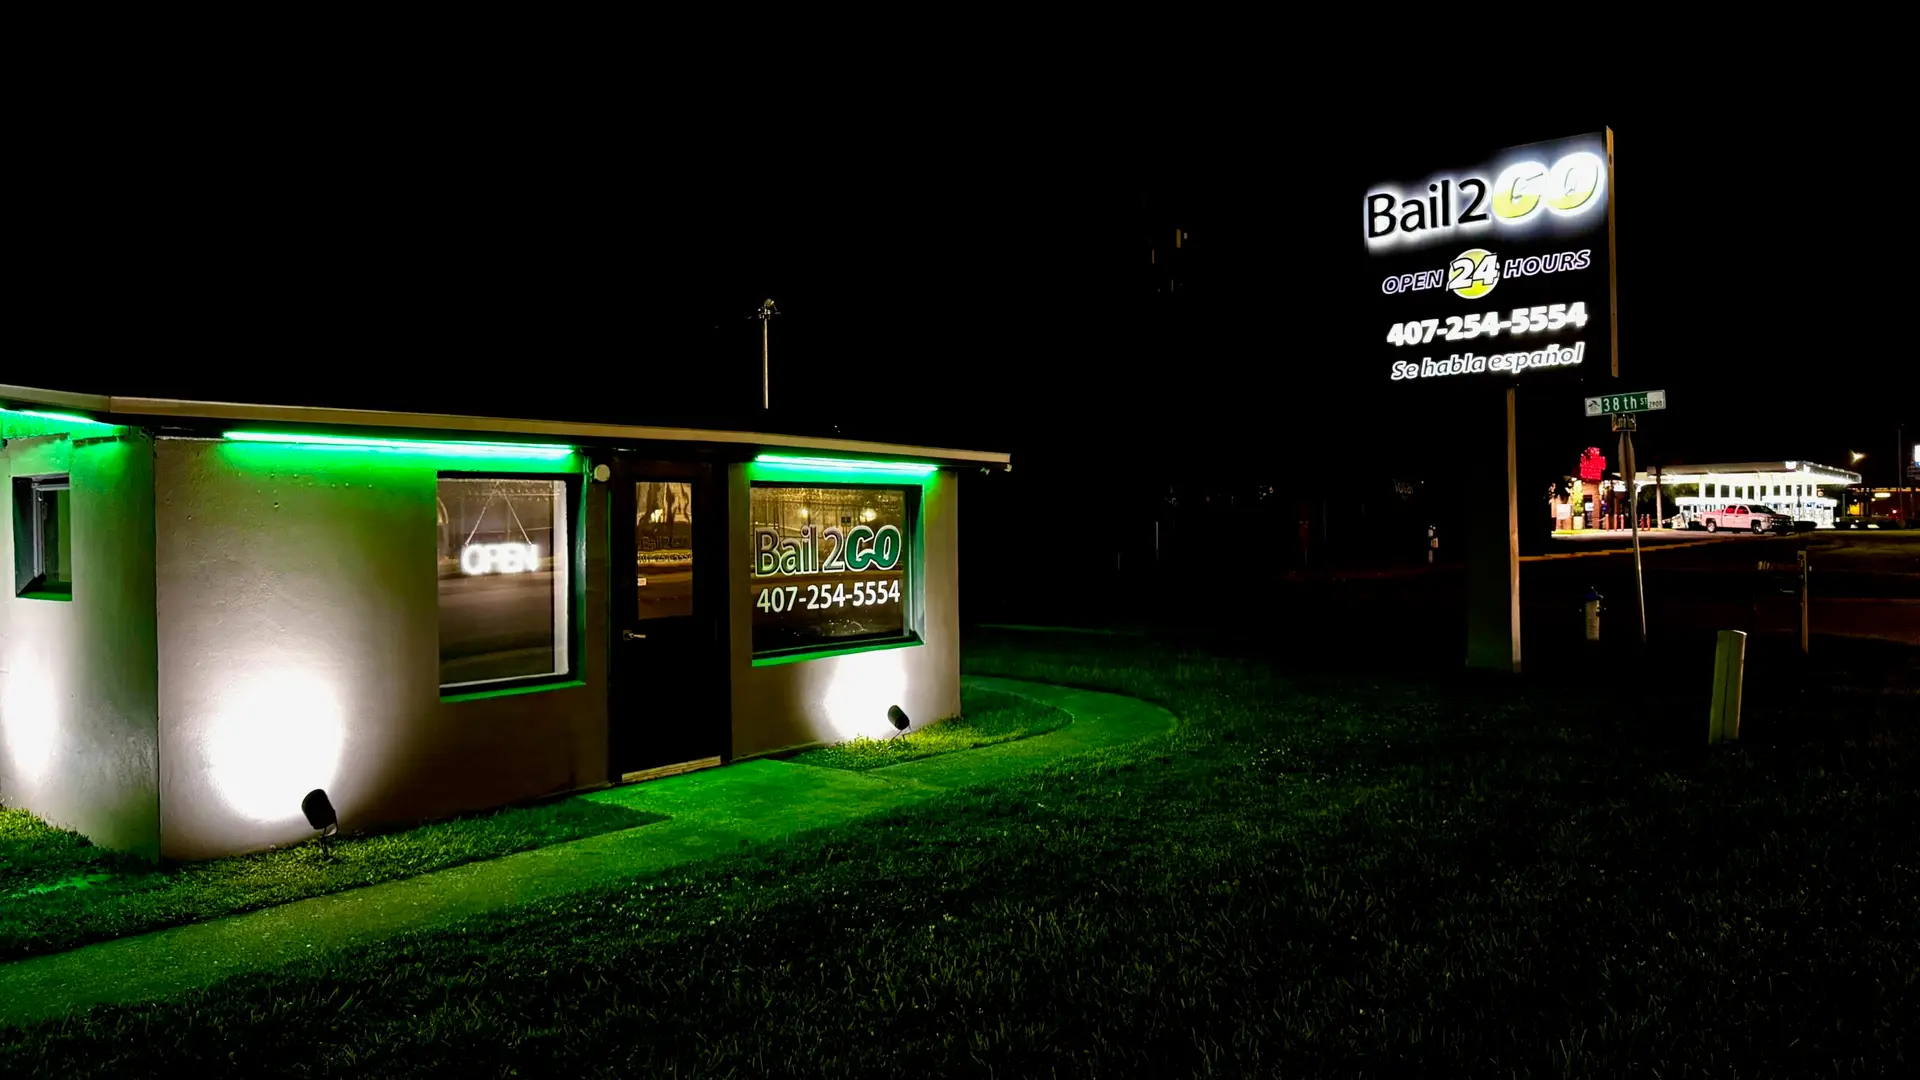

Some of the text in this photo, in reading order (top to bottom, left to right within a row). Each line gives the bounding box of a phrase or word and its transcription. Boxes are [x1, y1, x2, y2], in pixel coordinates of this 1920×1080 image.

[1382, 249, 1592, 294] OPEN 24 HOURS
[1386, 301, 1588, 346] 407-254-5554
[1391, 341, 1586, 380] Se habla español
[1603, 396, 1638, 412] 38th
[462, 543, 539, 575] OPEN
[756, 579, 901, 613] 407-254-5554
